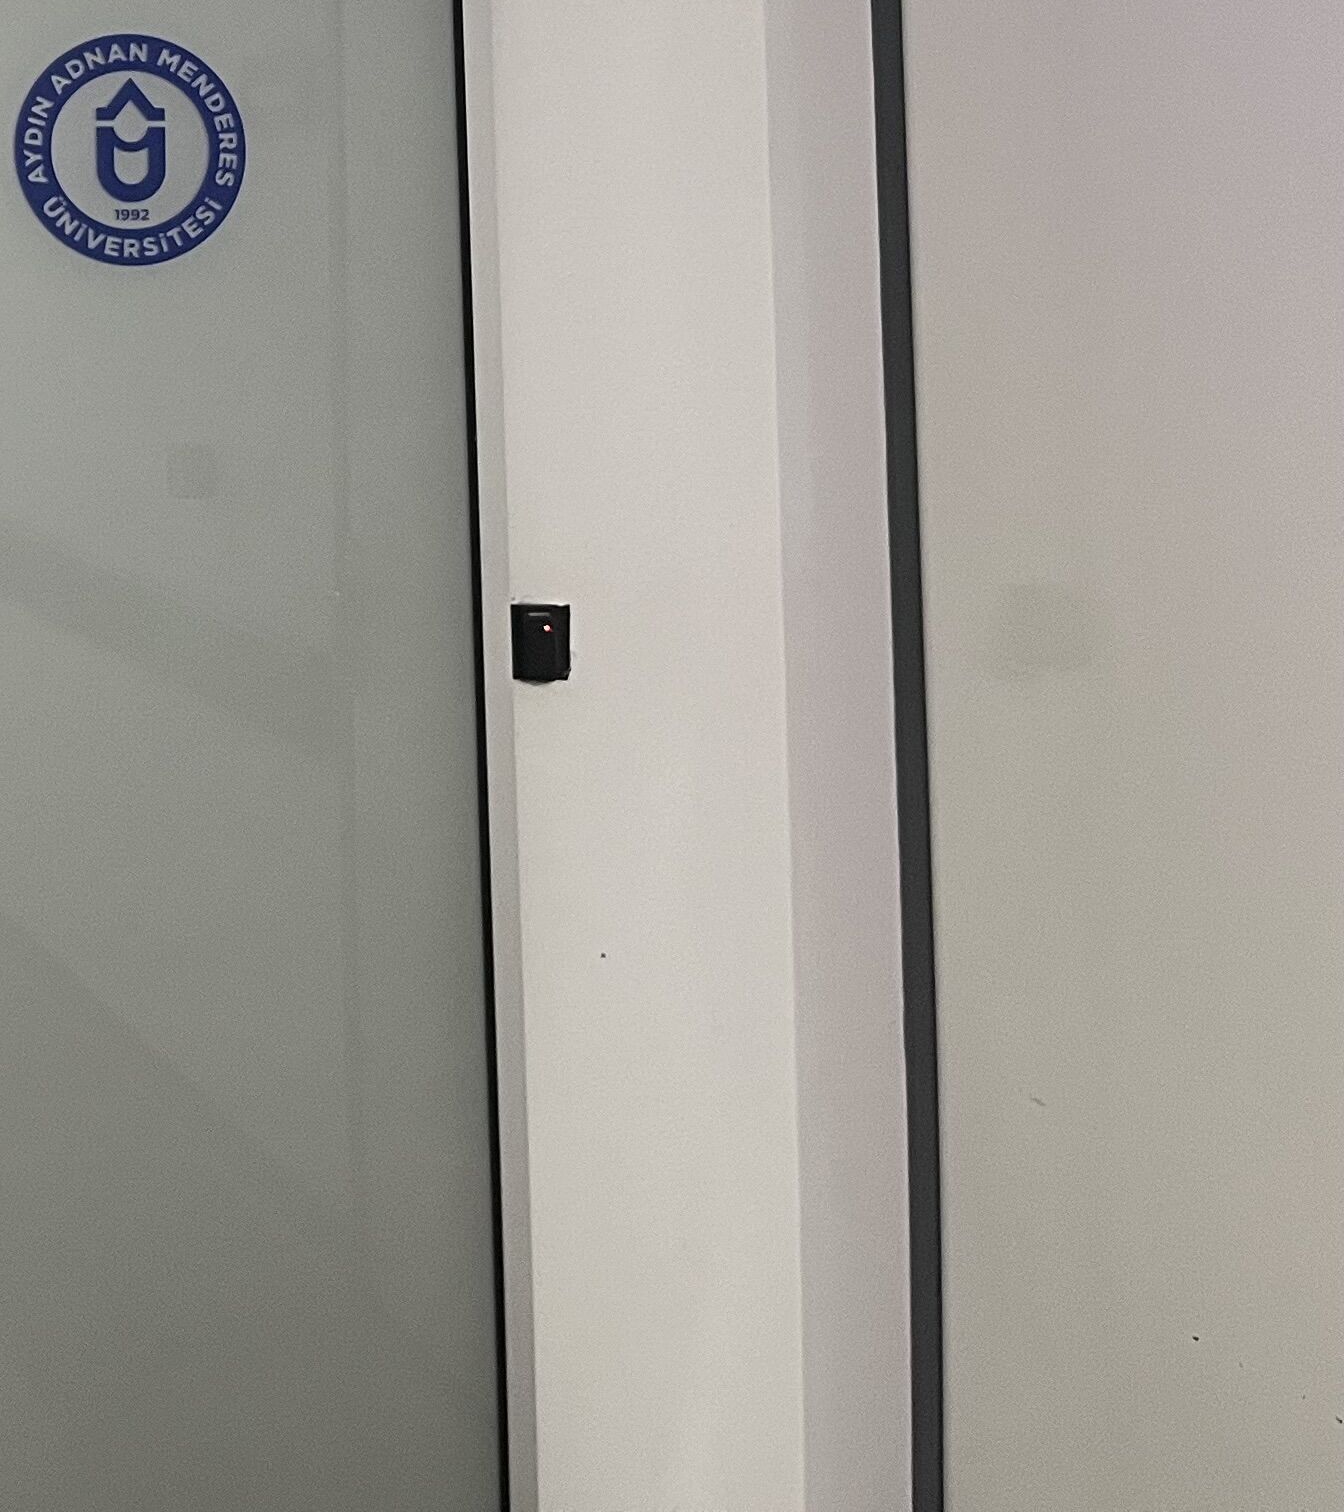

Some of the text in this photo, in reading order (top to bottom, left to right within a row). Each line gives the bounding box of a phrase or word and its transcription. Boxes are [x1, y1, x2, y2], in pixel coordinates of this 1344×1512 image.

[24, 42, 238, 188] AYDIN ADNAN MENDERES
[42, 195, 223, 259] ÜNİVERSİTESİ
[114, 208, 150, 222] 1992
